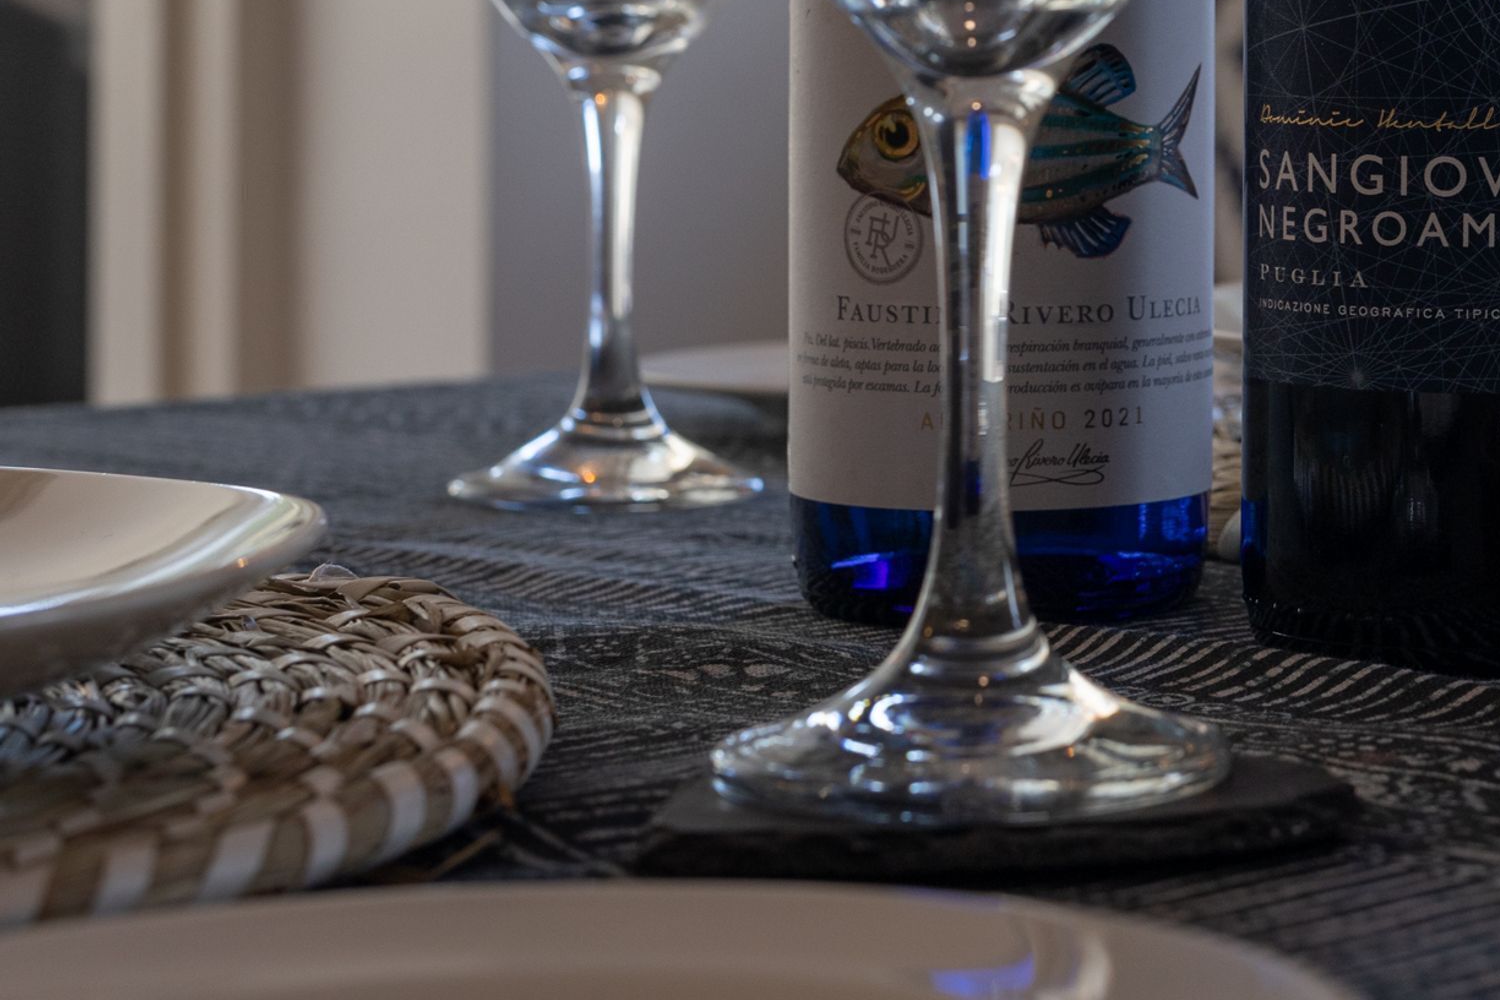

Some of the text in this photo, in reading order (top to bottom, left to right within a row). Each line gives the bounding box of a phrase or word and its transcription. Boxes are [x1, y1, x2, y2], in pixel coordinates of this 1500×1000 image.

[1259, 263, 1368, 288] PUGLIA
[836, 295, 1201, 325] FAUSTI RIVERO ULECIA
[1259, 297, 1330, 314] INDICAZIONE
[1338, 305, 1445, 320] GEOGRAFICA
[871, 337, 927, 353] Vertebrado
[855, 360, 881, 375] aptas
[883, 360, 910, 375] para
[912, 360, 924, 373] la
[1007, 359, 1080, 374] sustentación
[914, 380, 931, 393] La
[1008, 380, 1067, 394] roducción
[1083, 405, 1142, 429] 2021
